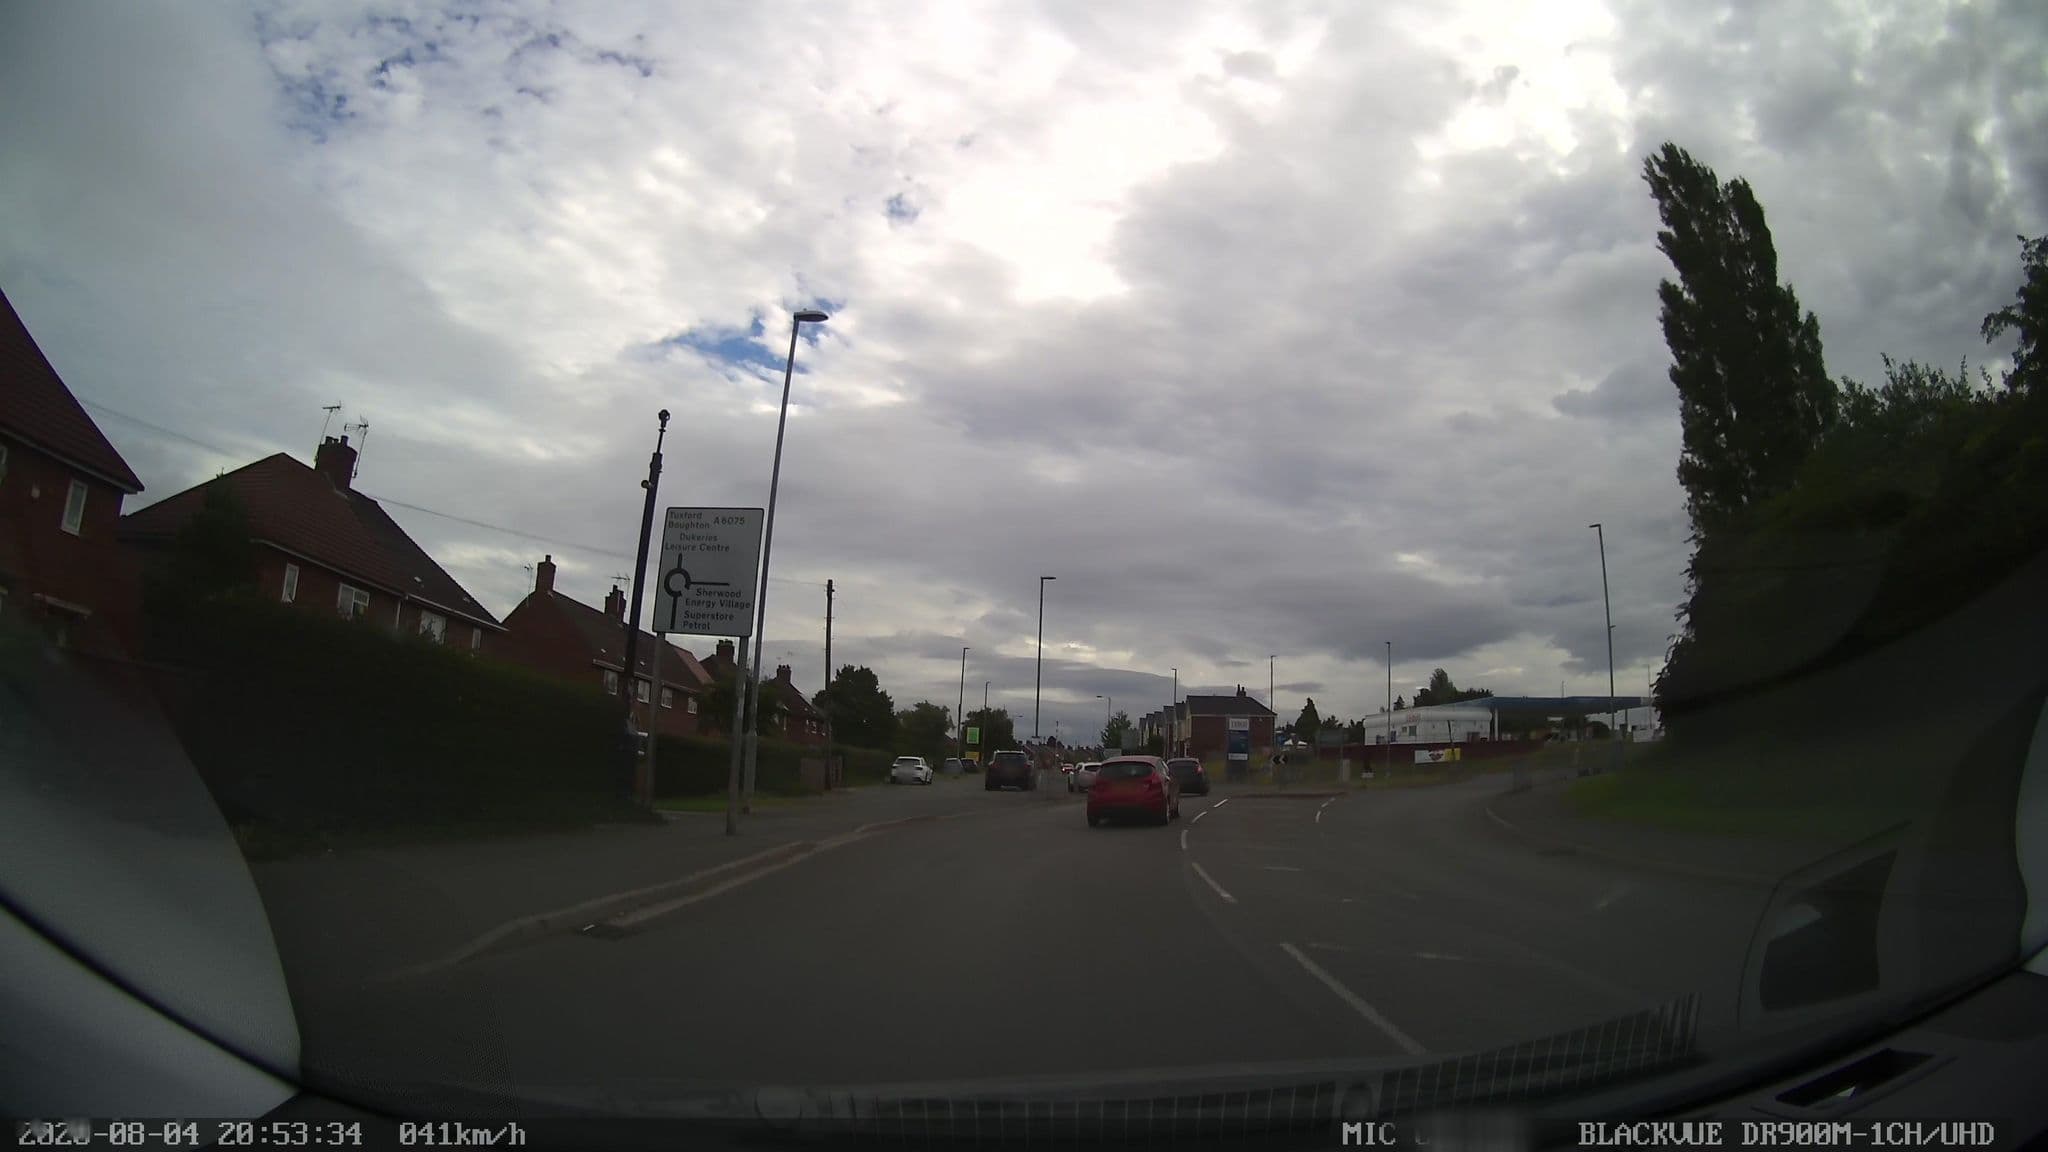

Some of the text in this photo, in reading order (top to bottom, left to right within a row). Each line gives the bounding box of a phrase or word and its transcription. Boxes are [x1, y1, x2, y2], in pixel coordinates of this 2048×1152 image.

[713, 516, 745, 526] A6075
[679, 533, 718, 541] Dukeries
[665, 543, 730, 552] Leisure Centre
[695, 587, 742, 598] Sherwood
[685, 598, 751, 610] Energy Village
[684, 611, 735, 621] Superstore
[682, 620, 711, 630] Petrol
